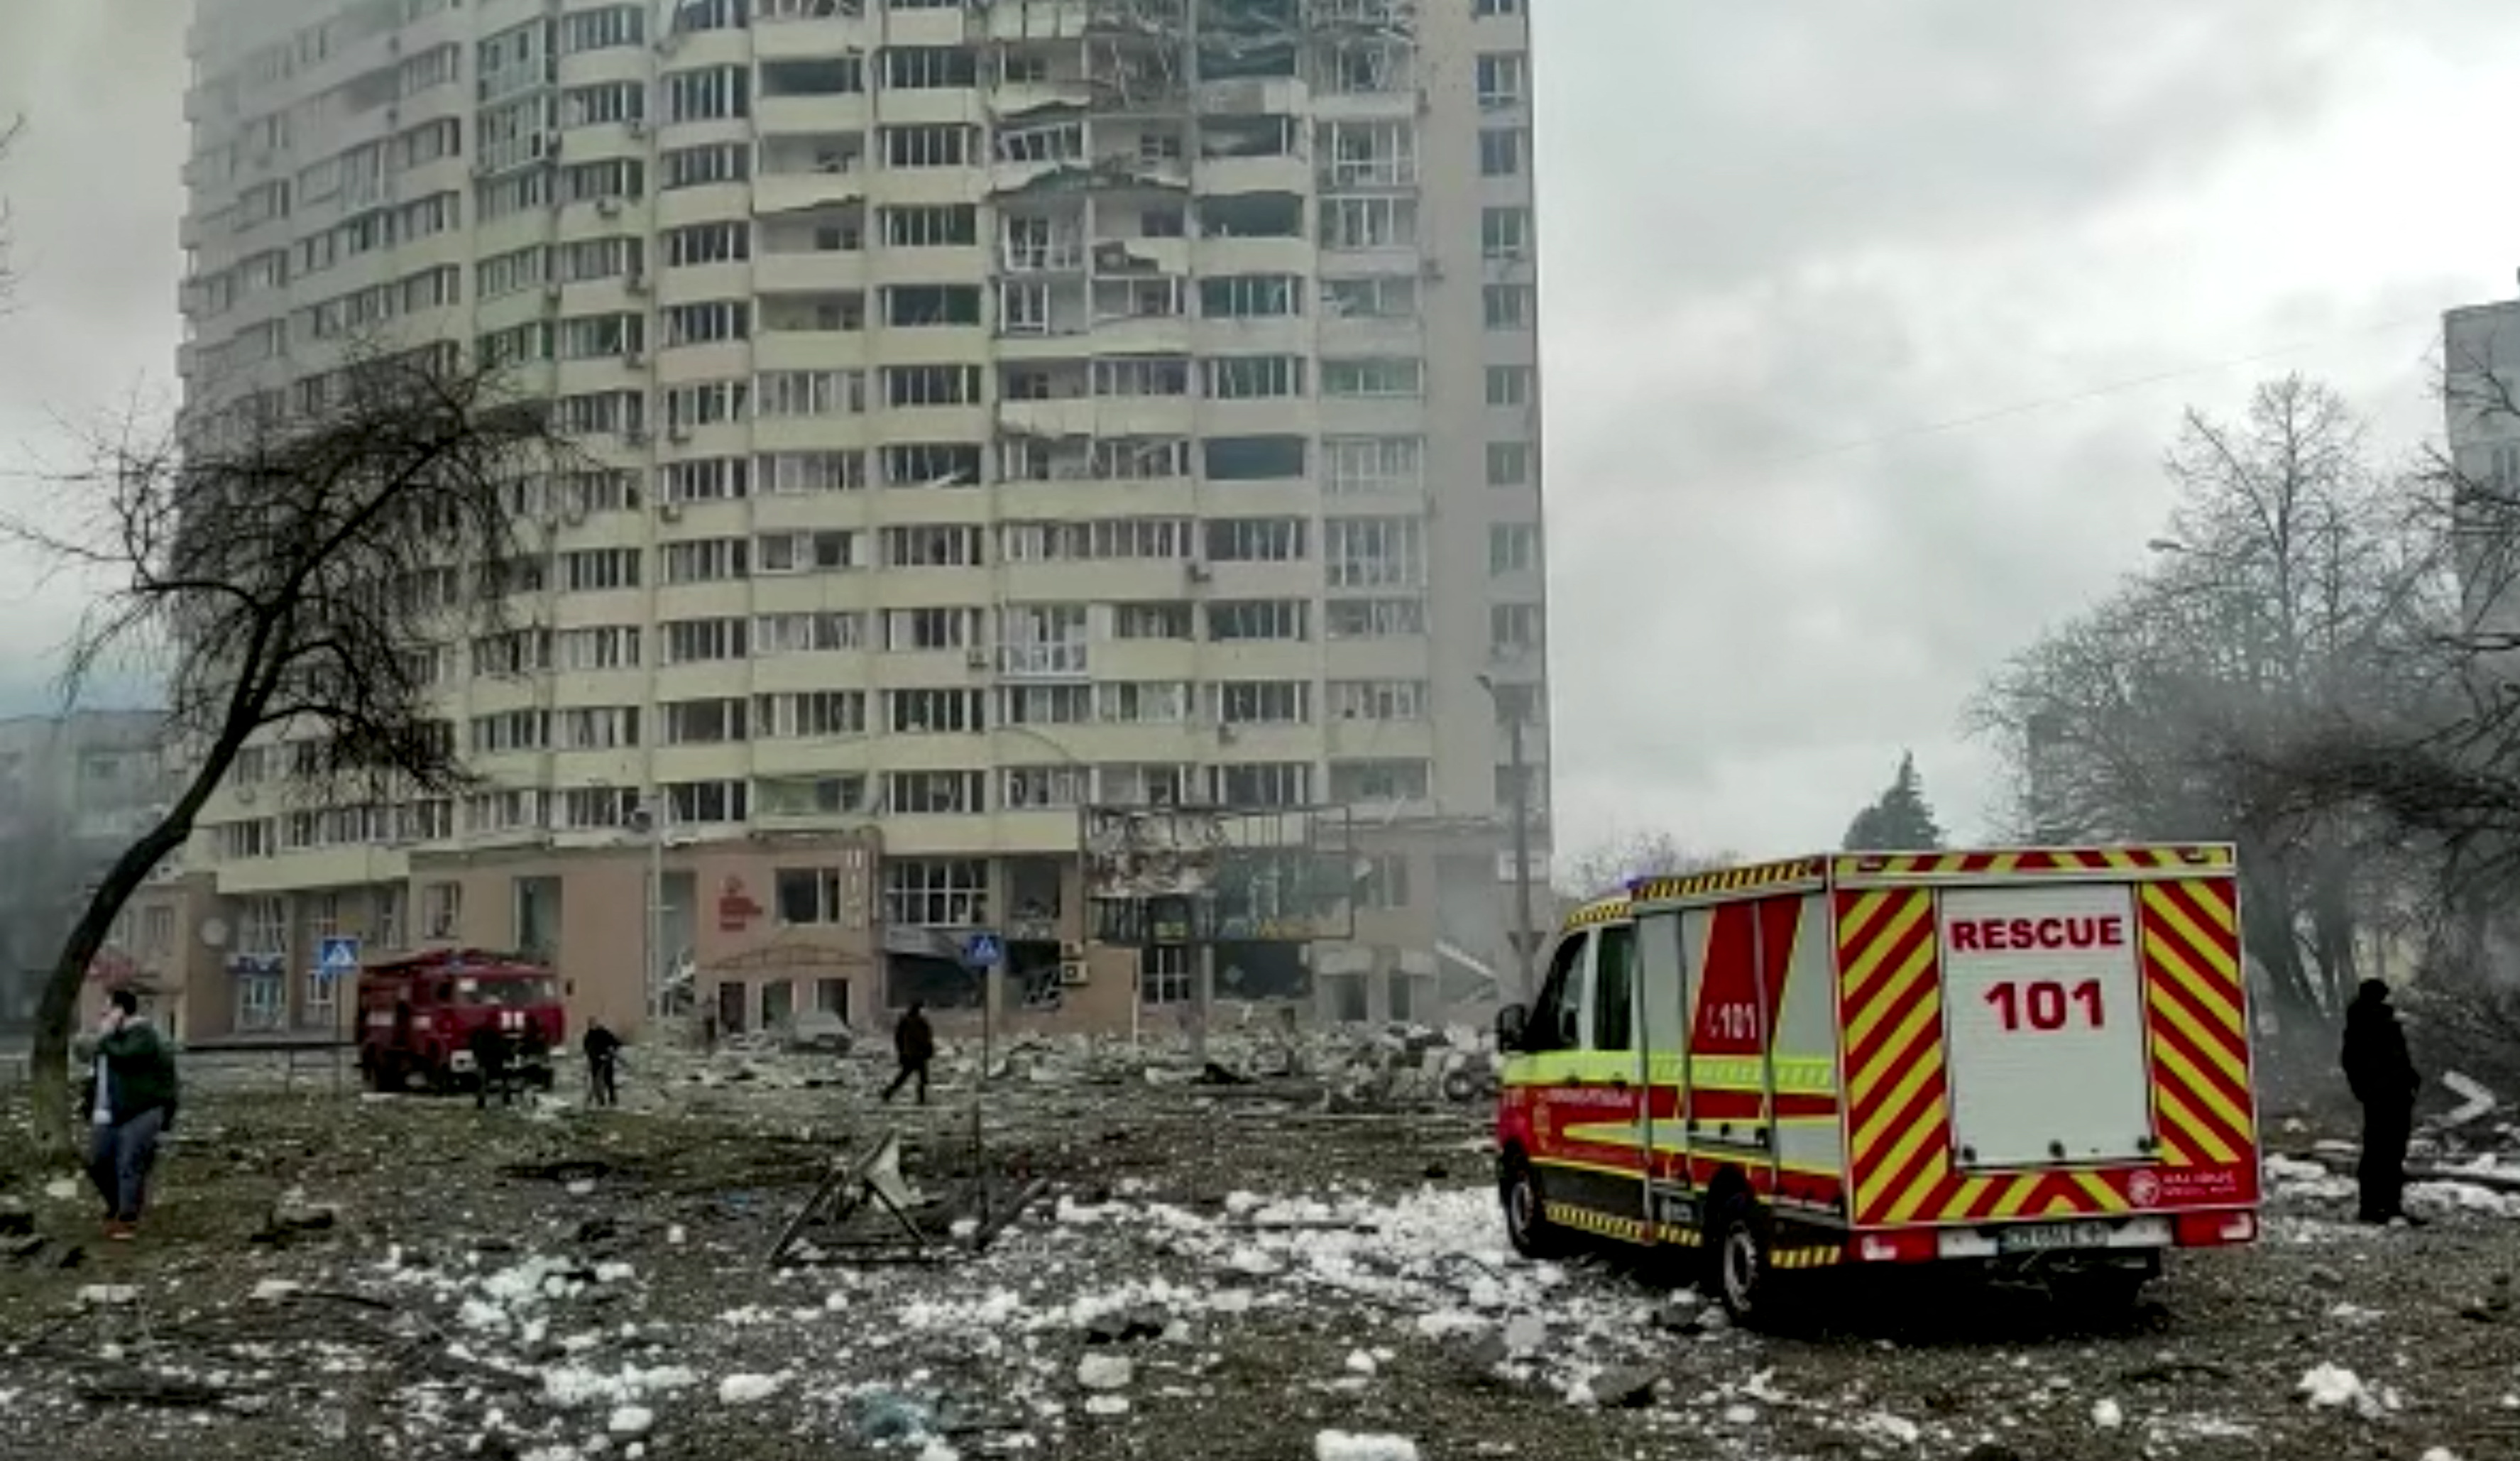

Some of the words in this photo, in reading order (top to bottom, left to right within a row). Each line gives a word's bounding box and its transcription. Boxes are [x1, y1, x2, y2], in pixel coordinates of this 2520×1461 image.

[1950, 916, 2124, 950] RESCUE
[1719, 1002, 1757, 1039] 101
[1985, 978, 2103, 1031] 101
